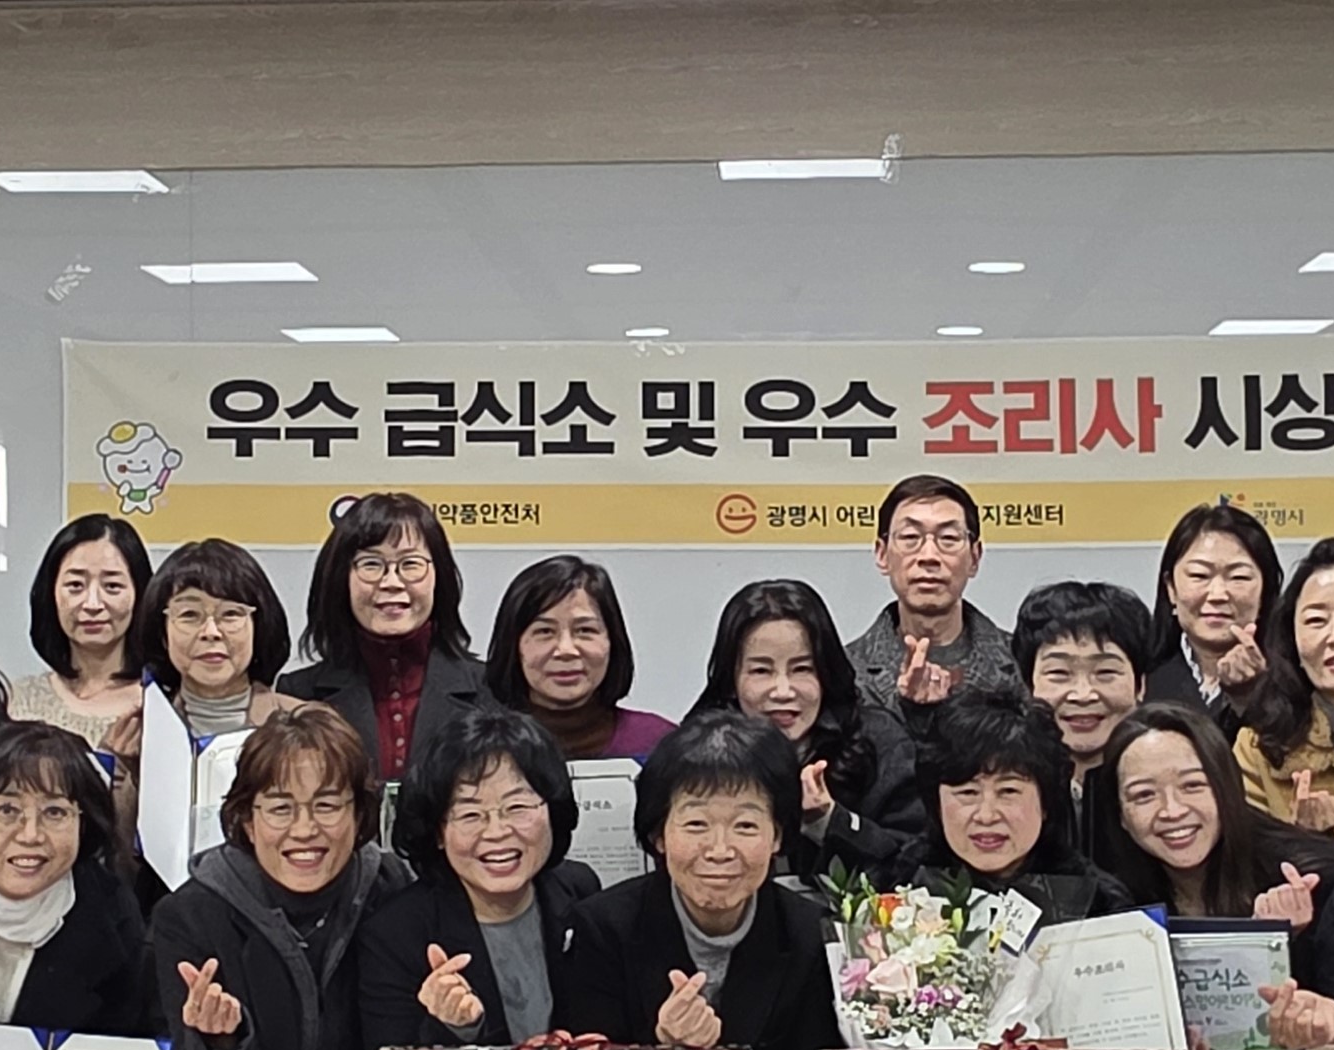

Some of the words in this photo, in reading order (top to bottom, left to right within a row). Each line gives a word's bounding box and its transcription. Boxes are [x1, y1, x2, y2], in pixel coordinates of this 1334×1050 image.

[206, 379, 359, 458] 우수
[384, 380, 617, 458] 급식소
[641, 381, 718, 457] 및
[743, 379, 897, 457] 우수
[922, 376, 1162, 454] 조리사
[432, 503, 541, 525] 약품안전처
[766, 504, 827, 527] 광명시
[1253, 509, 1304, 526] 광명시
[1178, 968, 1252, 990] 수급식소
